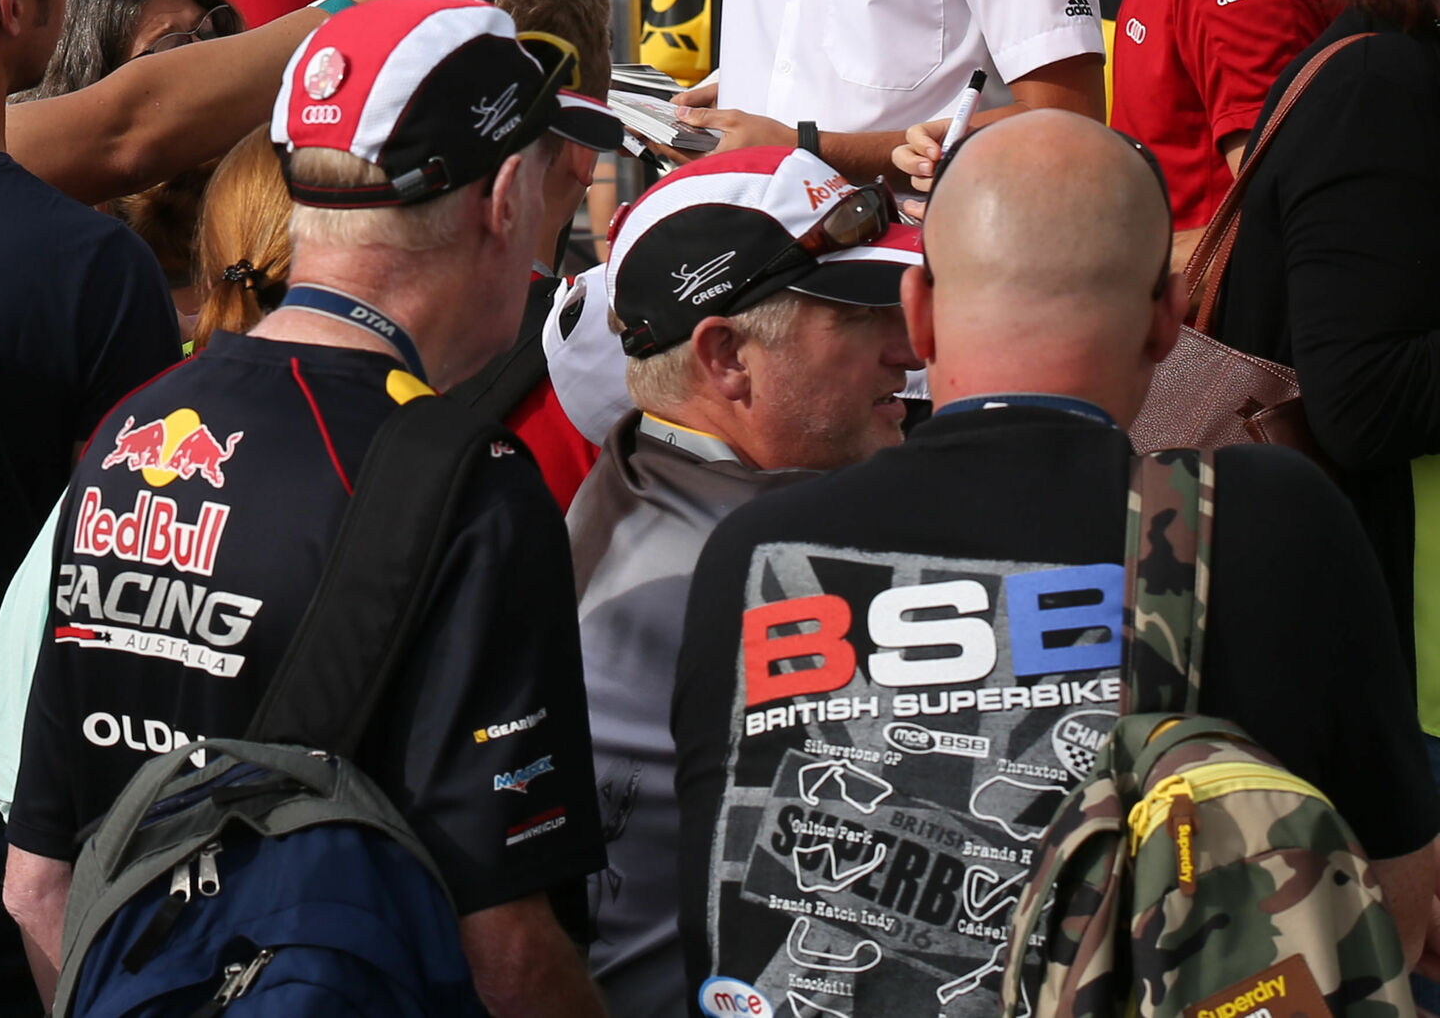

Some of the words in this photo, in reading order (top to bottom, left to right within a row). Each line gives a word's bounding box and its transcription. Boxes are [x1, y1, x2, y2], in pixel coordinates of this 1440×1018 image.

[492, 113, 522, 142] GREEN
[691, 280, 733, 305] GREEN
[349, 305, 397, 337] DTM
[73, 486, 152, 562] Red
[141, 494, 232, 577] Bull
[56, 563, 264, 647] RACING
[742, 562, 1125, 708] BSB
[745, 694, 880, 738] BRITISH
[803, 738, 881, 763] Silverstone
[882, 750, 904, 767] GP
[939, 735, 987, 752] BSB
[996, 758, 1069, 782] Thruxton
[838, 826, 874, 846] Park
[889, 810, 972, 850] BRITIS
[961, 840, 1017, 864] Brands
[1176, 823, 1194, 883] Superdry
[768, 894, 813, 915] Brands
[814, 901, 857, 924] Hatch
[860, 909, 896, 932] Indy
[787, 973, 855, 998] Knockhill
[713, 991, 763, 1015] mce
